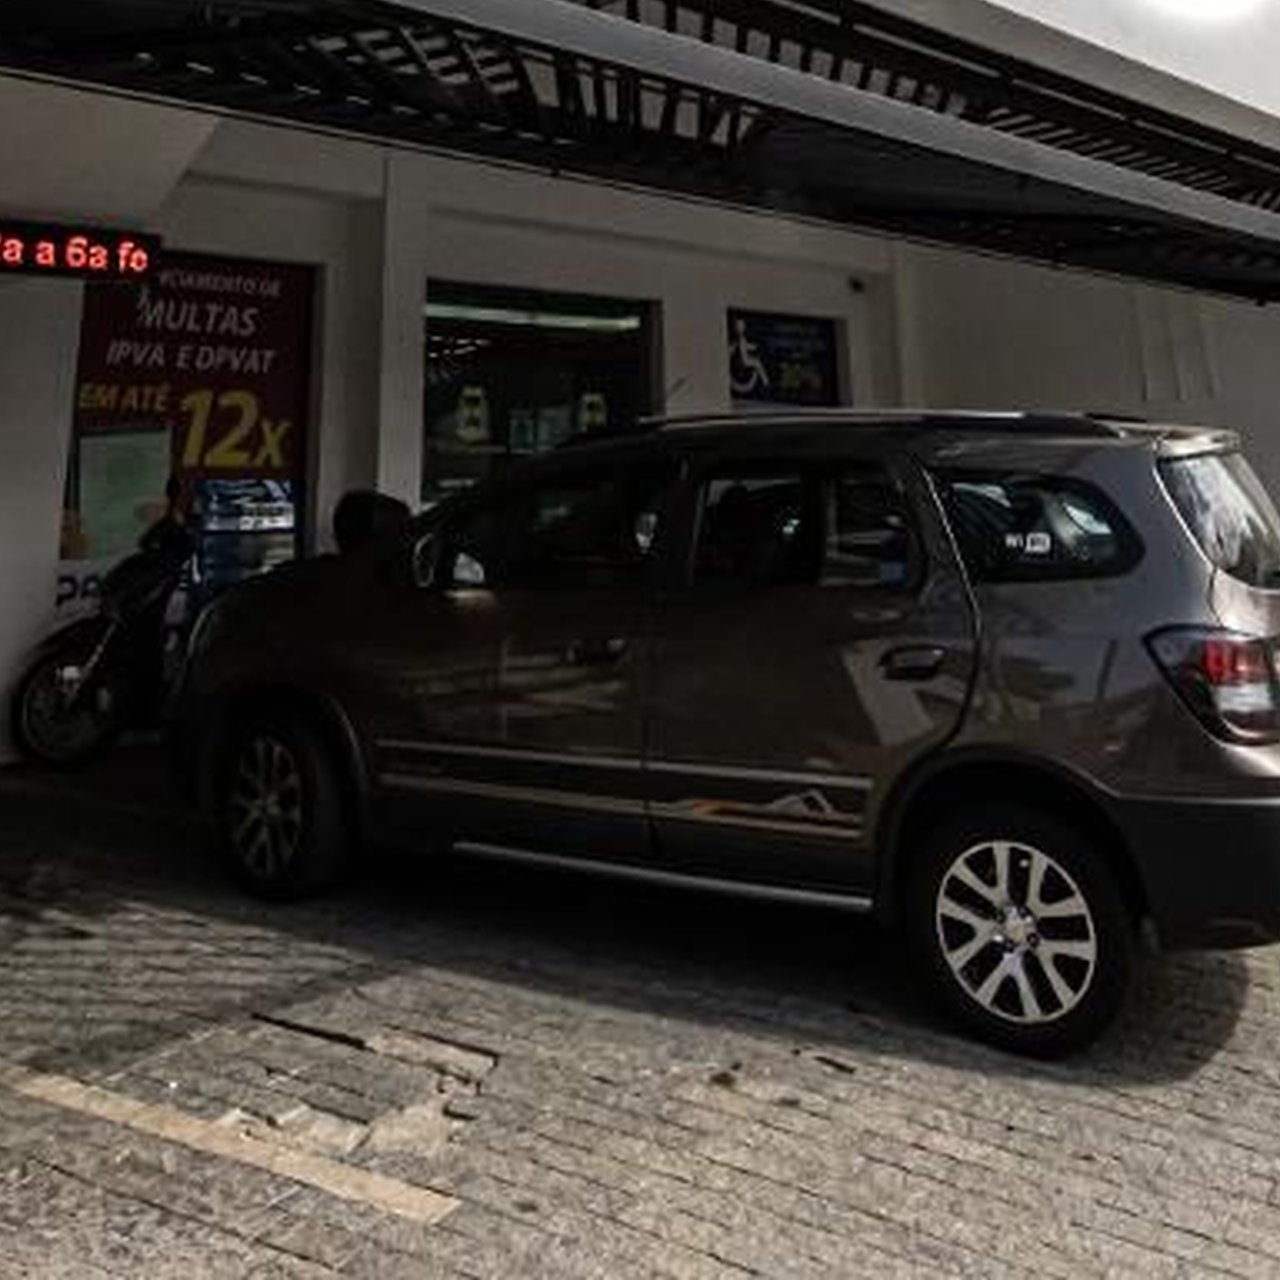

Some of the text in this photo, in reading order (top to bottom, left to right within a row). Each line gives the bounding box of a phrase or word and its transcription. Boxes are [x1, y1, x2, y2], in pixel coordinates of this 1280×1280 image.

[35, 241, 55, 265] a
[65, 236, 108, 268] 6a
[140, 297, 260, 337] MULTAS
[106, 340, 277, 374] IPVA E DPVAT
[79, 382, 119, 409] EM
[126, 382, 169, 411] ATÉ
